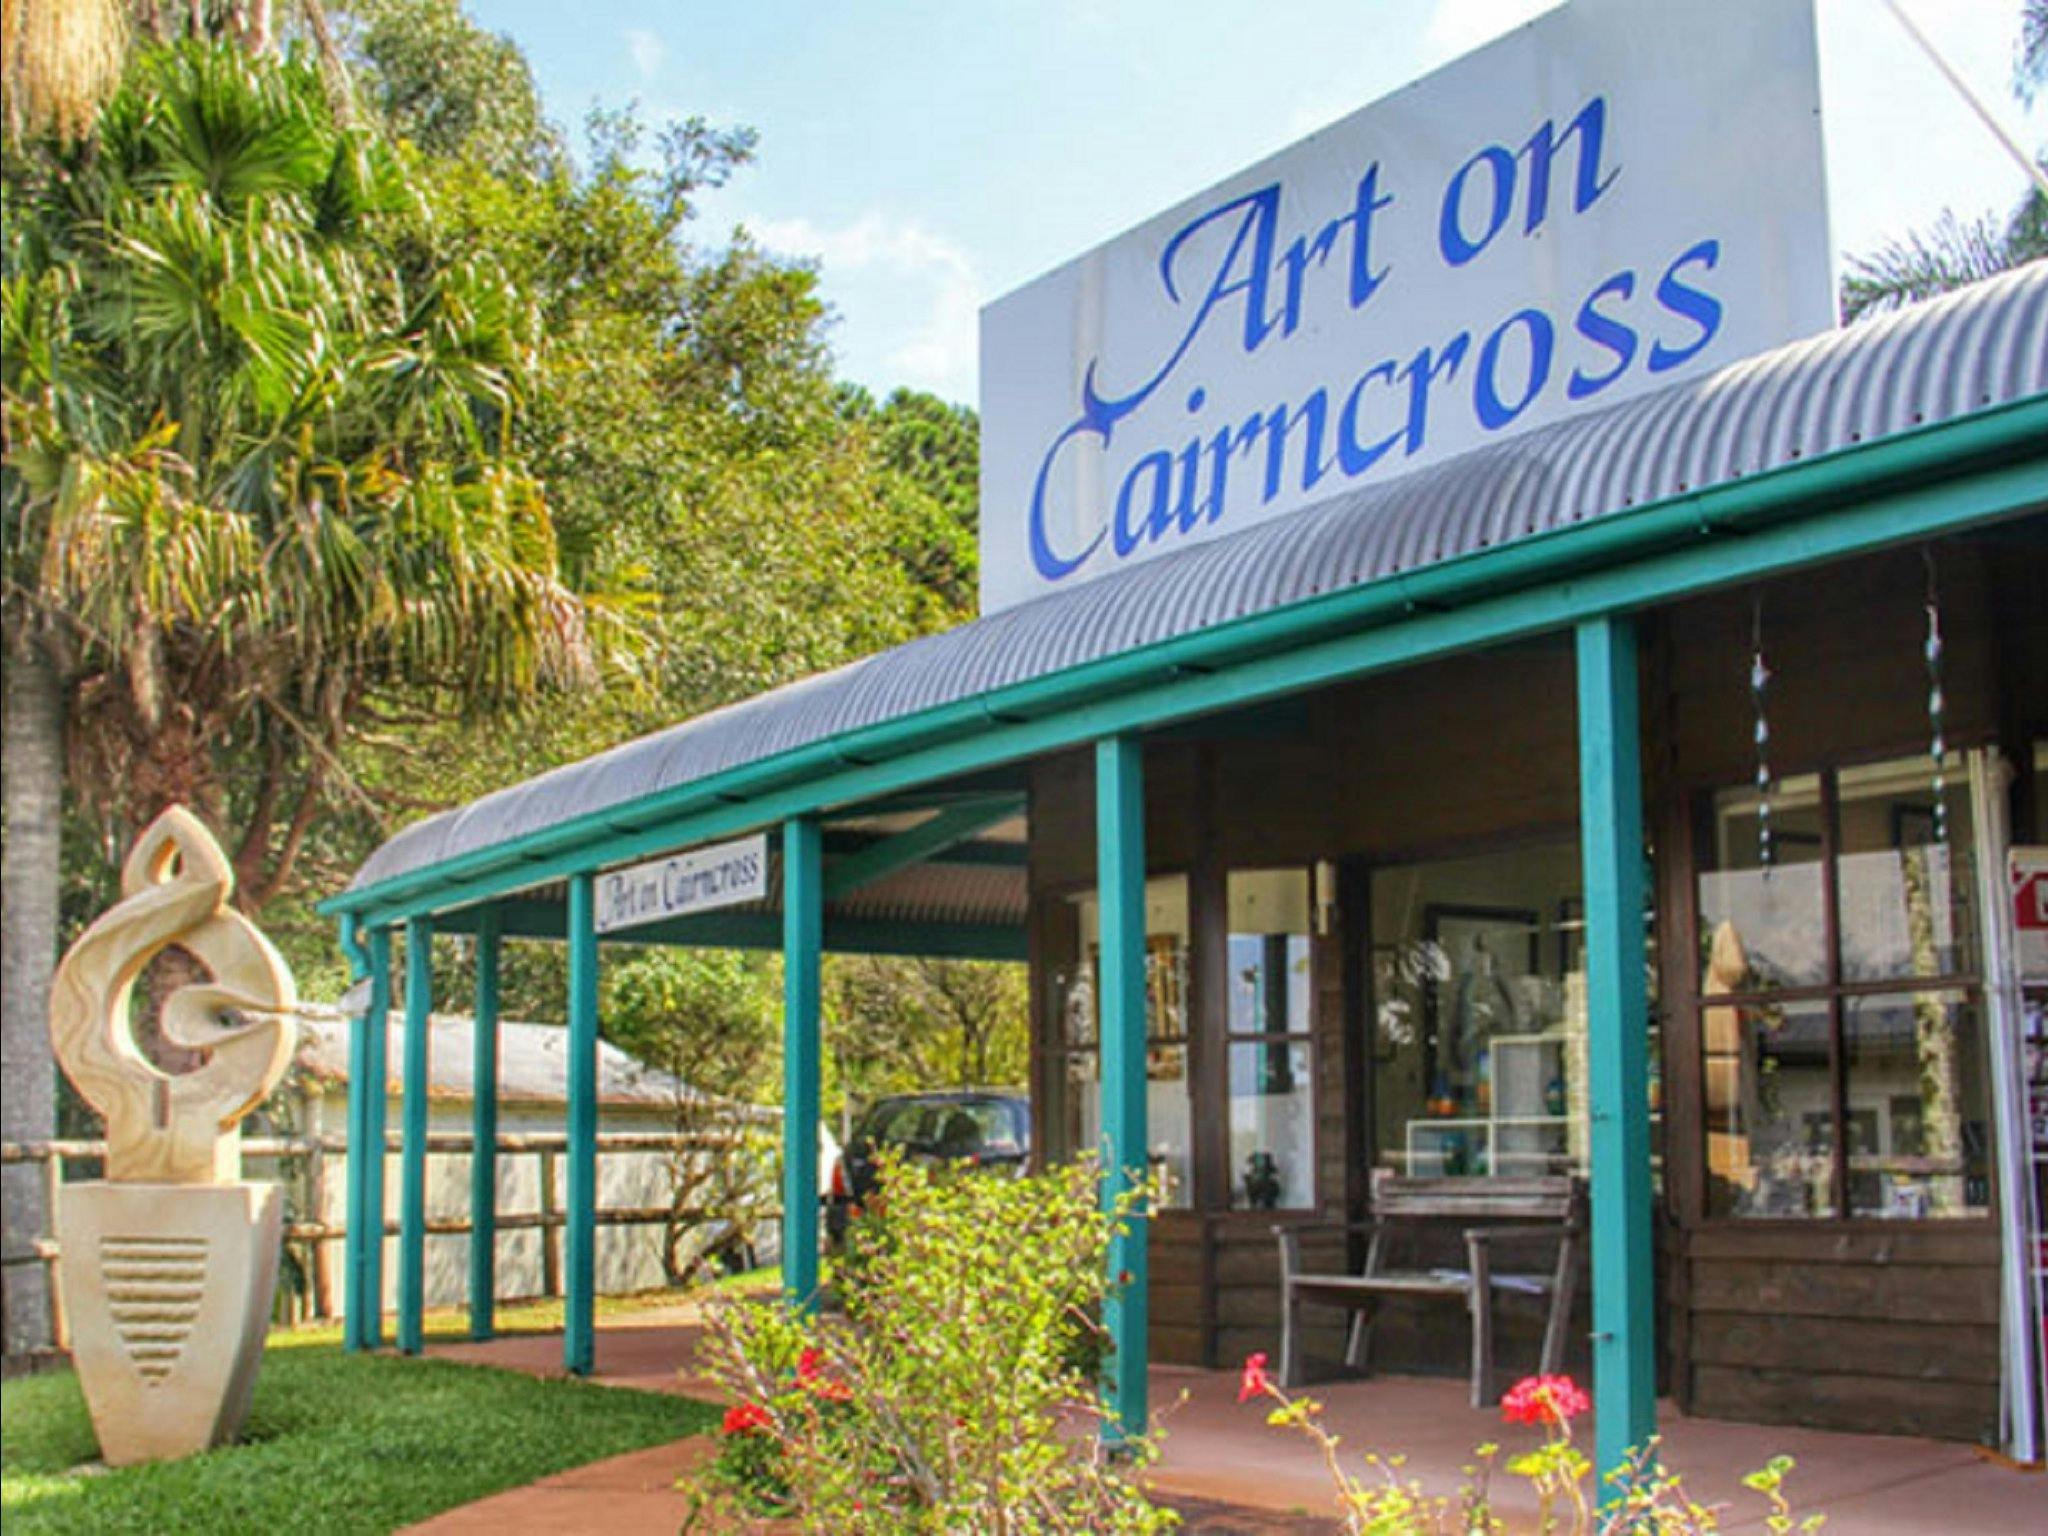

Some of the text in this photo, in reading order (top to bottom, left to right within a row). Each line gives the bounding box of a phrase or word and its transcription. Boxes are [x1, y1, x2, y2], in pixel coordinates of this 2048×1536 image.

[1085, 96, 1622, 406] Art on
[1029, 239, 1722, 581] Cairncross
[600, 852, 760, 926] Art on Cairncross
